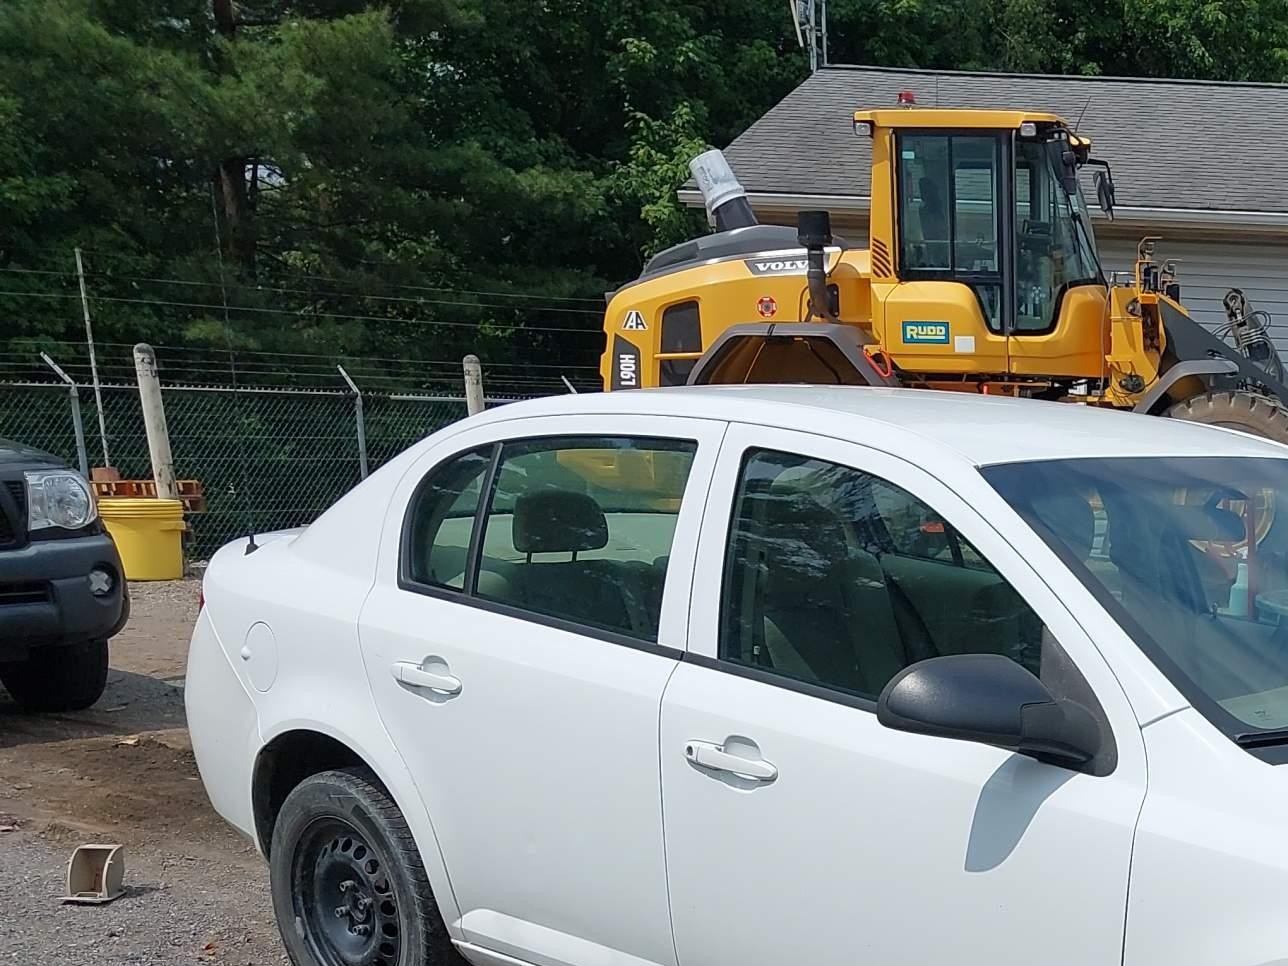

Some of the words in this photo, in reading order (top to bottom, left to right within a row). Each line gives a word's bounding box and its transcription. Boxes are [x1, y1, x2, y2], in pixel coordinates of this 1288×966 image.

[755, 260, 809, 271] VOLV
[906, 325, 946, 339] RUDD
[619, 354, 636, 386] L90H
